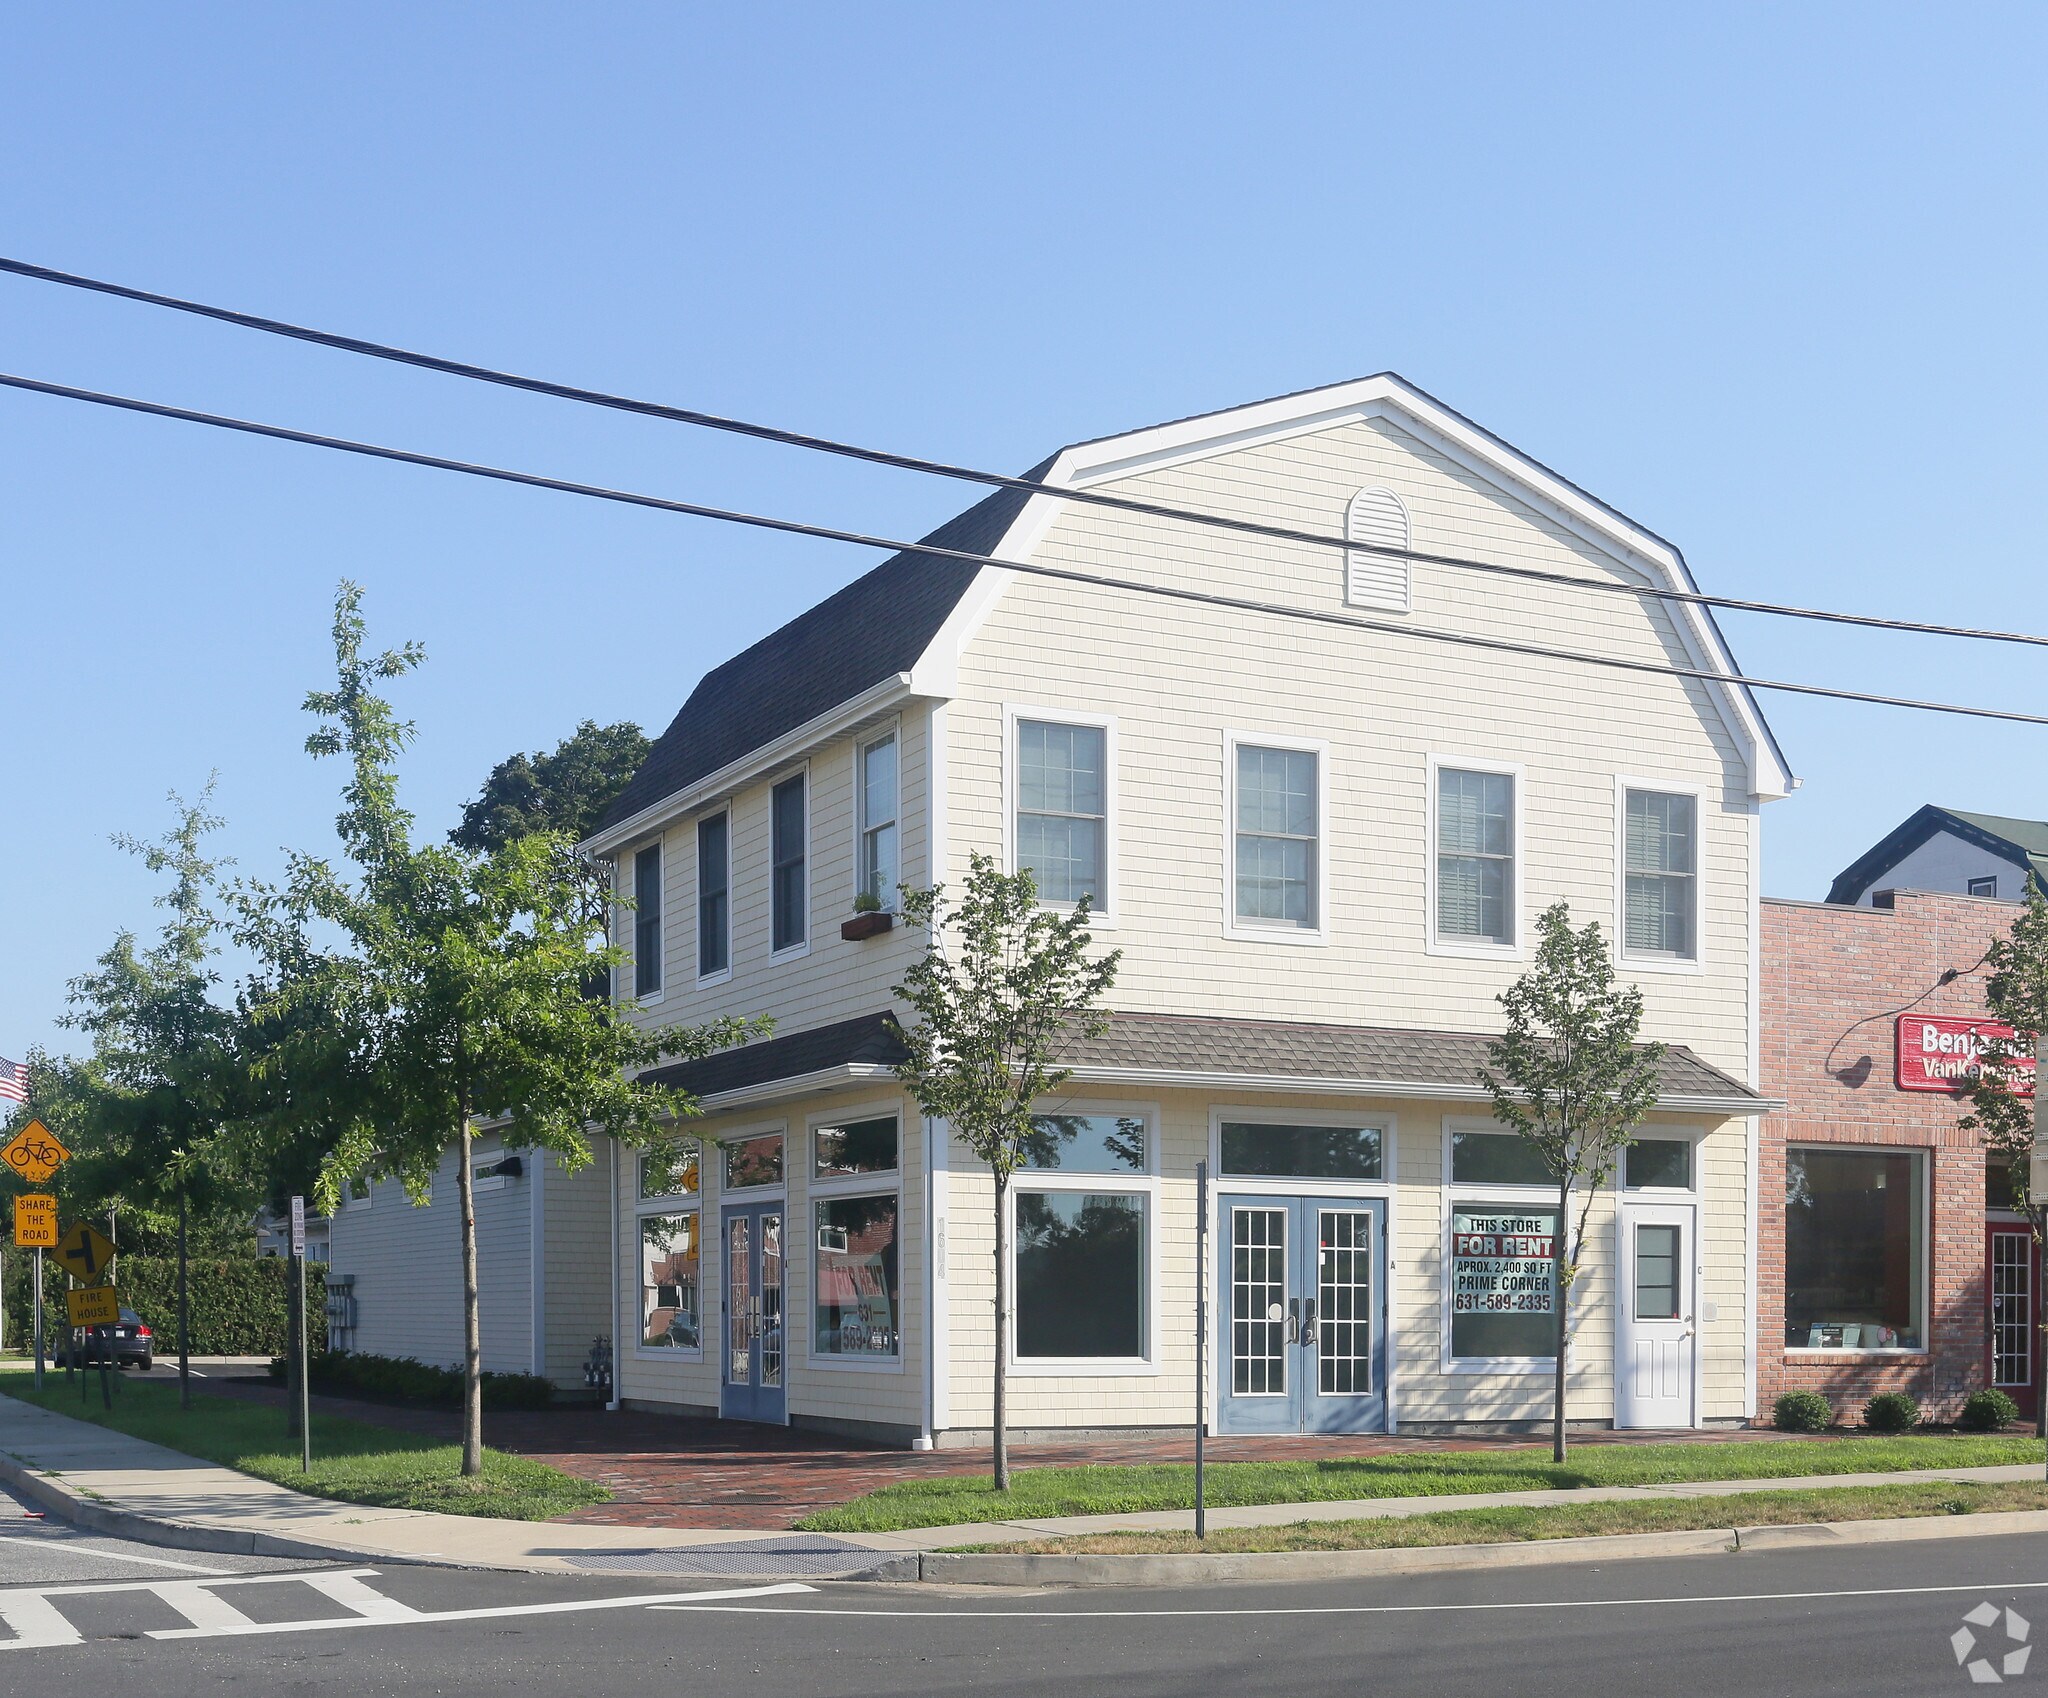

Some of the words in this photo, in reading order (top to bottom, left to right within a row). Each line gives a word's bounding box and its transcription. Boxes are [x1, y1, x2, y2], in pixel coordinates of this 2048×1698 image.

[1922, 1024, 2035, 1060] Benjain
[20, 1200, 51, 1210] SHARE
[27, 1215, 44, 1225] THE
[1470, 1219, 1497, 1232] THIS
[1501, 1220, 1541, 1233] STORE
[23, 1230, 48, 1239] ROAD
[1457, 1236, 1496, 1255] FOR
[1502, 1238, 1552, 1256] RENT
[1457, 1261, 1492, 1273] APROX.
[1494, 1262, 1521, 1275] 2,400
[1524, 1263, 1537, 1275] SQ
[1540, 1263, 1551, 1274] FT
[1458, 1276, 1497, 1290] PRIME
[1501, 1277, 1549, 1291] CORNER
[80, 1292, 102, 1303] FIRE
[1456, 1294, 1550, 1310] 631-589-2335
[77, 1307, 109, 1319] HOUSE
